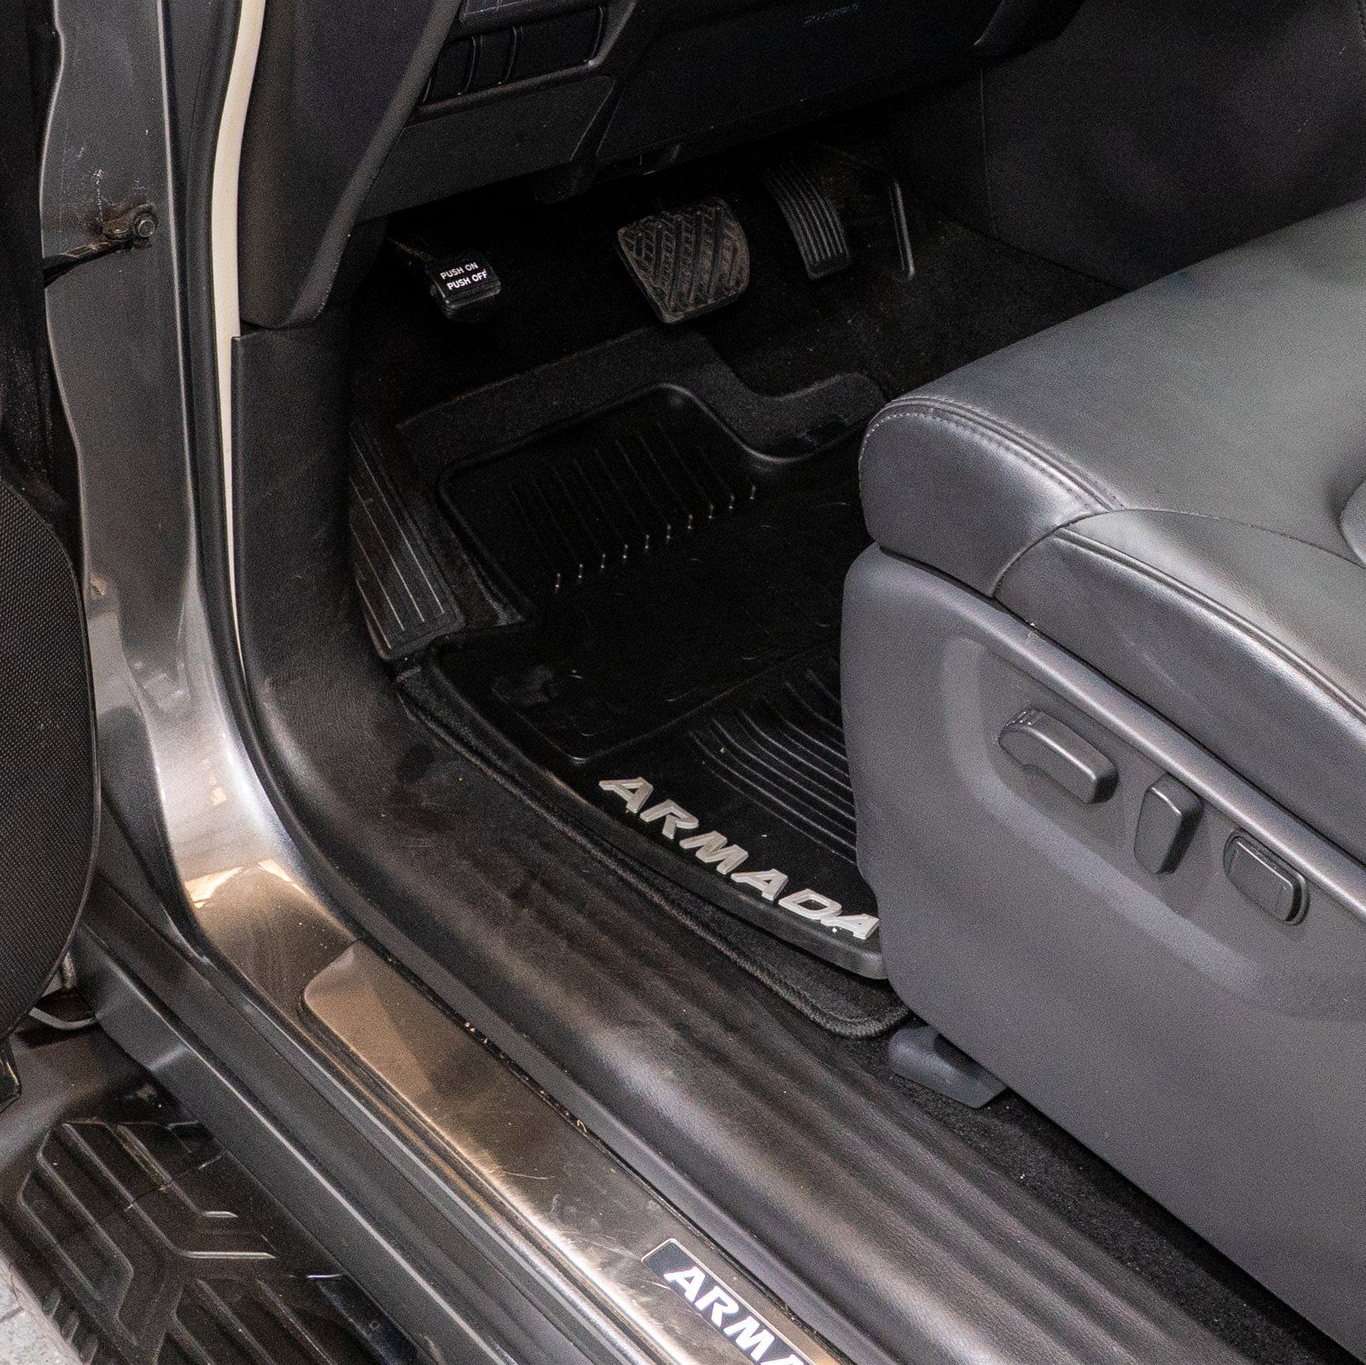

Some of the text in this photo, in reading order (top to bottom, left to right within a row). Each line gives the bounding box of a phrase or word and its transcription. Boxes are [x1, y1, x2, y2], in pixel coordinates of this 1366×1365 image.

[440, 262, 479, 280] PUSH ON
[447, 269, 487, 290] PUSH OFF
[598, 776, 880, 940] ARMADA
[663, 1265, 804, 1365] ARM
